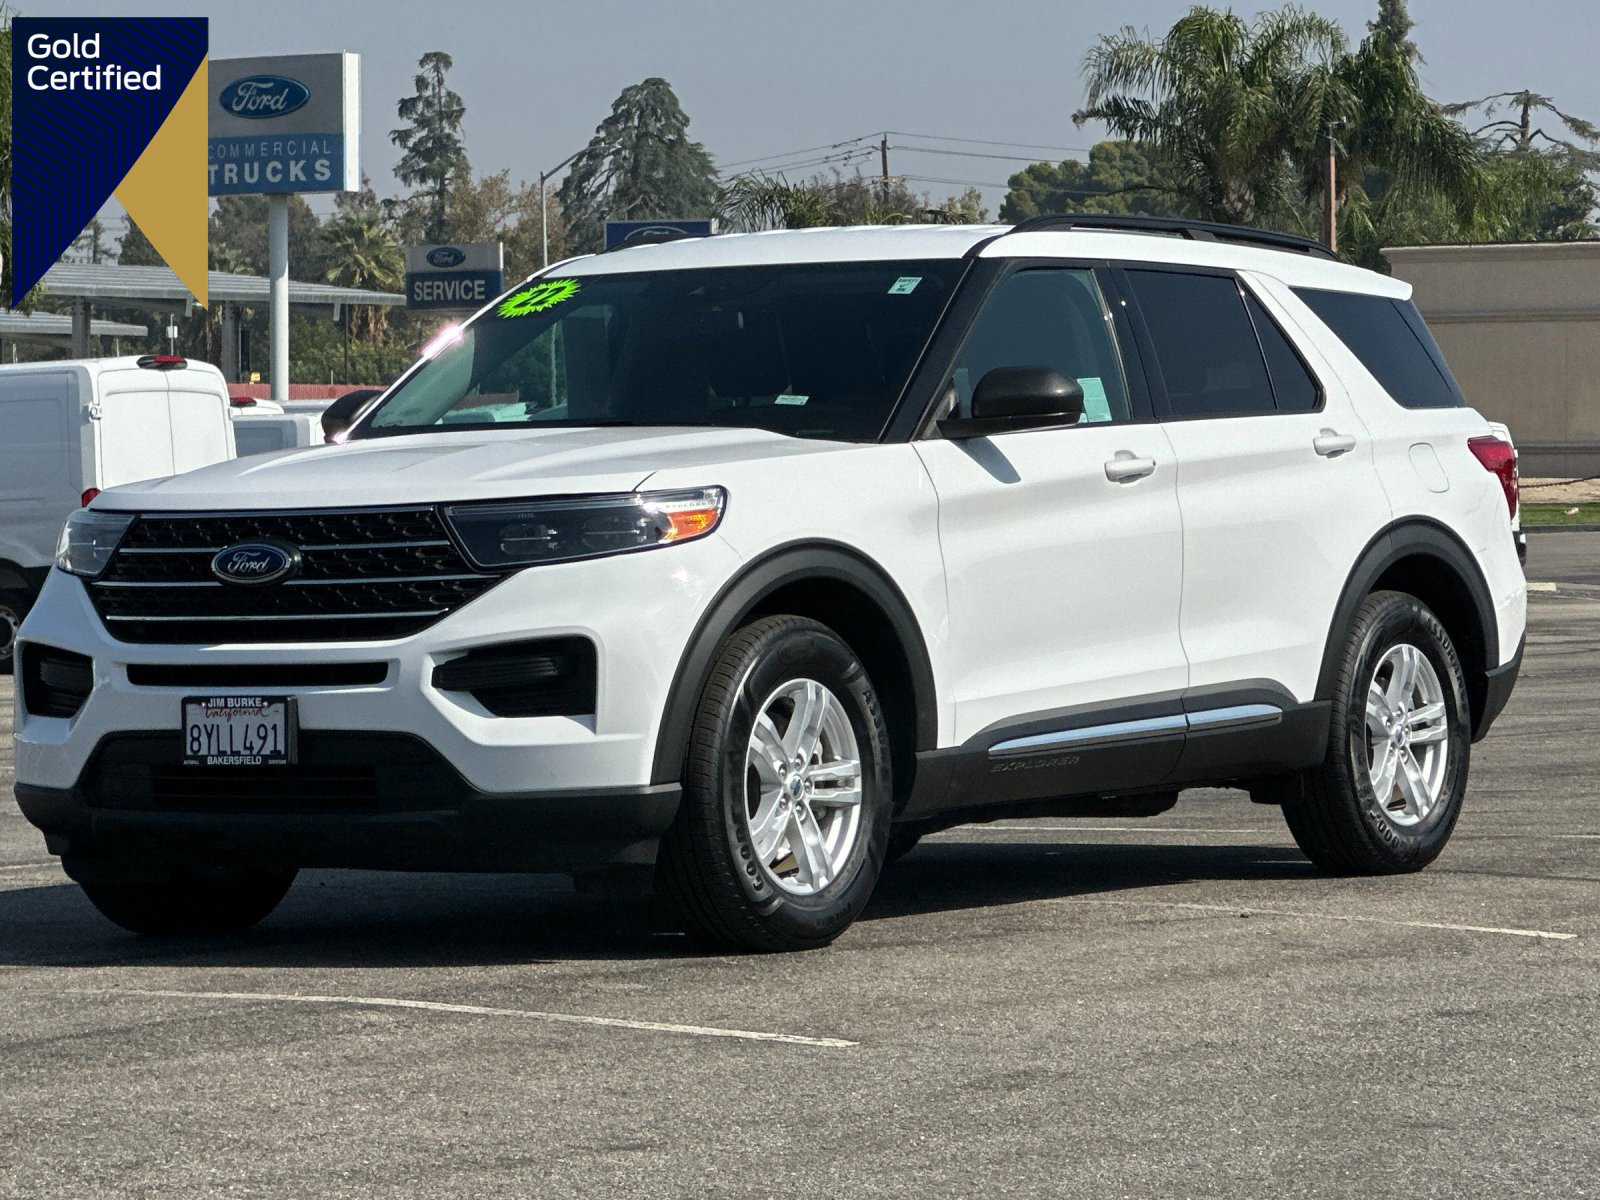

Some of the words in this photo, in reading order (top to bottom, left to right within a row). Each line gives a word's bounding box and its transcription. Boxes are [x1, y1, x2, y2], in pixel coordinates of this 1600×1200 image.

[232, 81, 289, 111] Ford
[208, 140, 332, 160] COMMERCIAL
[208, 158, 331, 185] TRUCKS
[433, 251, 455, 264] Ford
[413, 280, 486, 301] SERVICE
[227, 551, 271, 573] Ford
[207, 697, 225, 708] JIM
[227, 697, 262, 708] BURKE
[205, 706, 270, 722] California
[189, 723, 283, 755] 8YLL491
[207, 755, 262, 766] BAKERSFIELD
